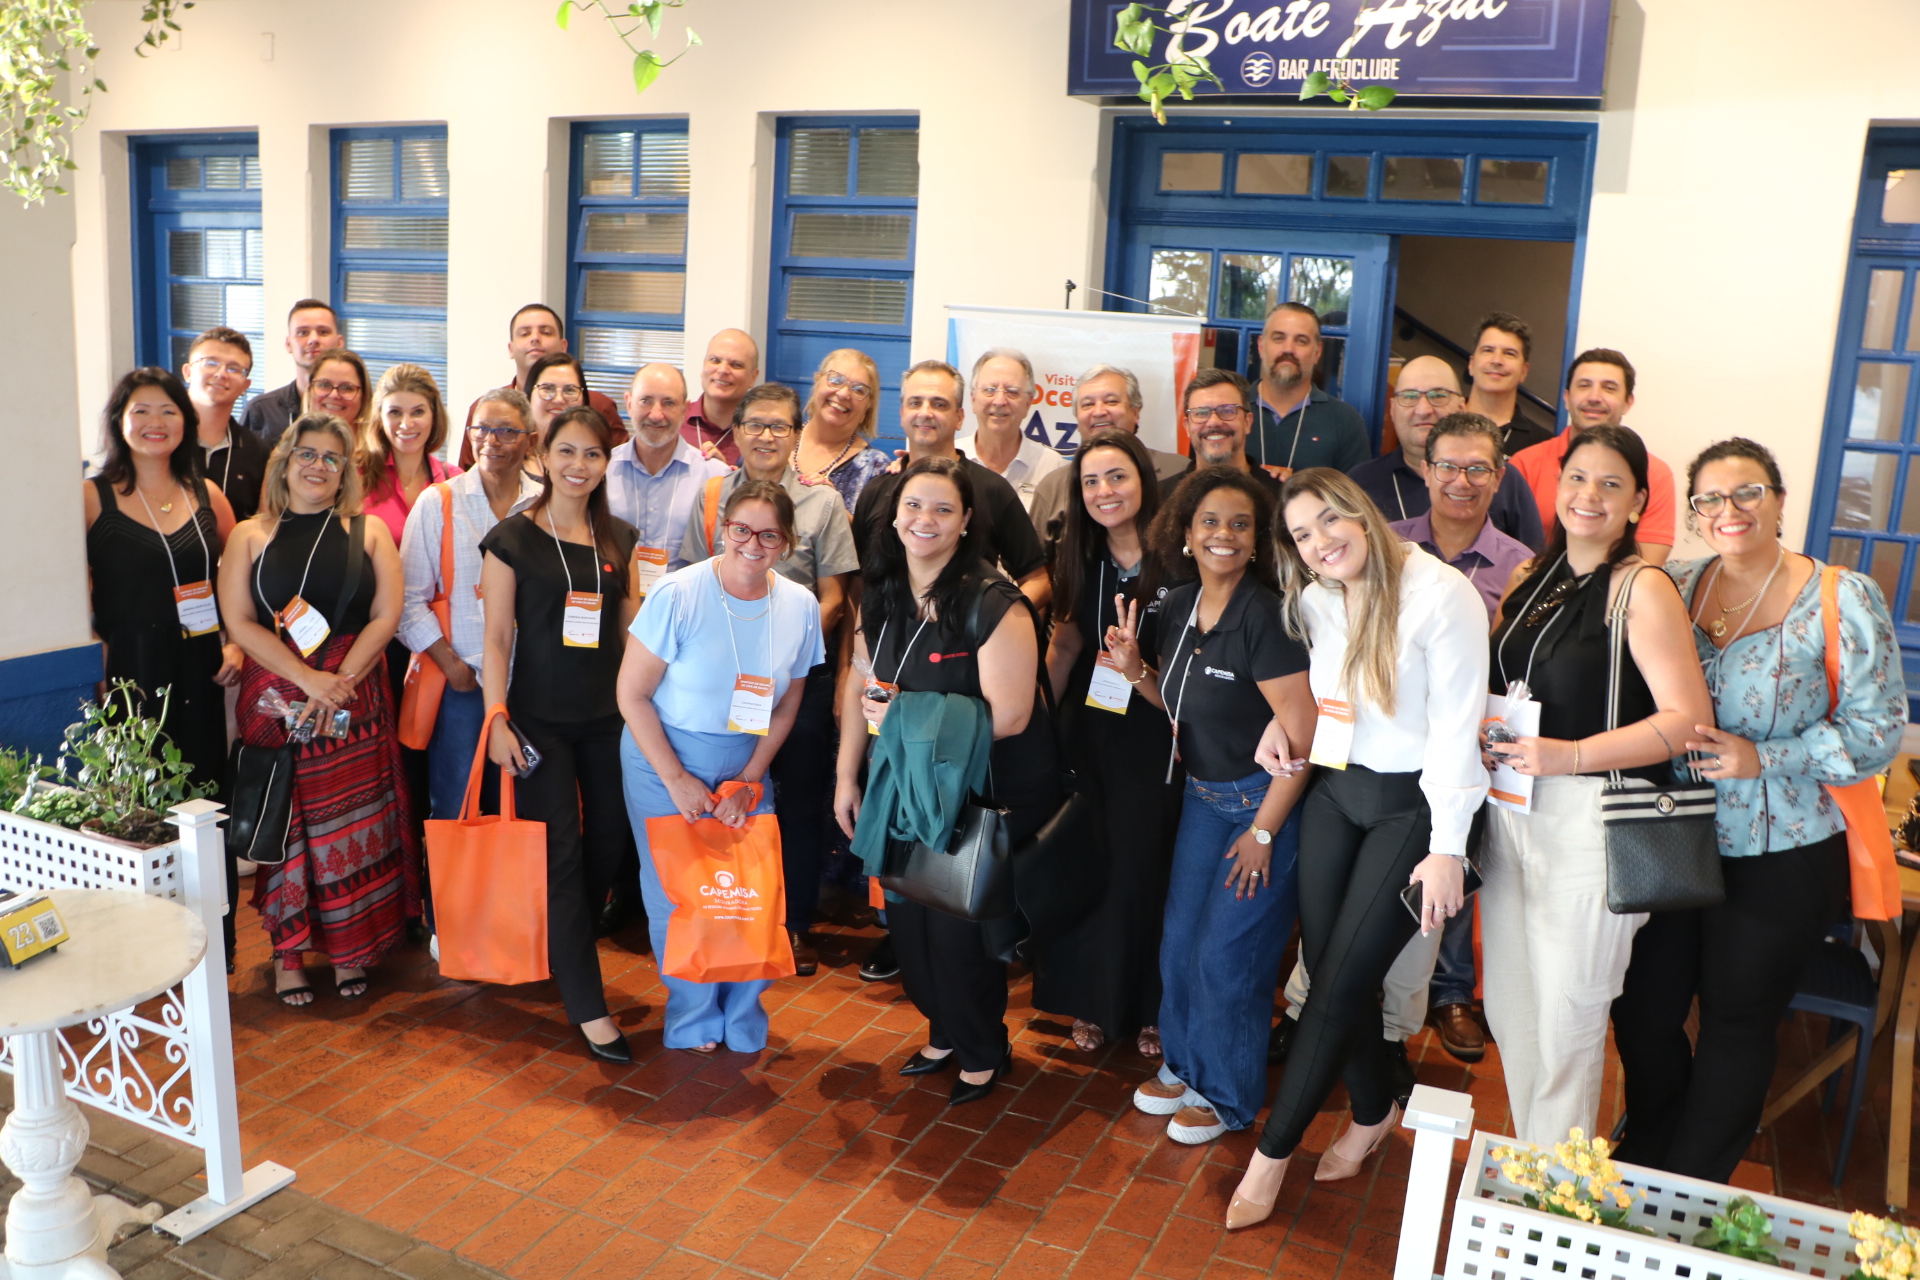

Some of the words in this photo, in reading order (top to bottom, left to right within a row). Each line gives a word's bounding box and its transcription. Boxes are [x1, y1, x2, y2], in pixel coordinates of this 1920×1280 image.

[1278, 58, 1308, 80] BAR
[1045, 373, 1077, 386] Visit
[1024, 409, 1079, 449] Az
[700, 885, 759, 899] CAPEMISA
[8, 921, 36, 950] 23
